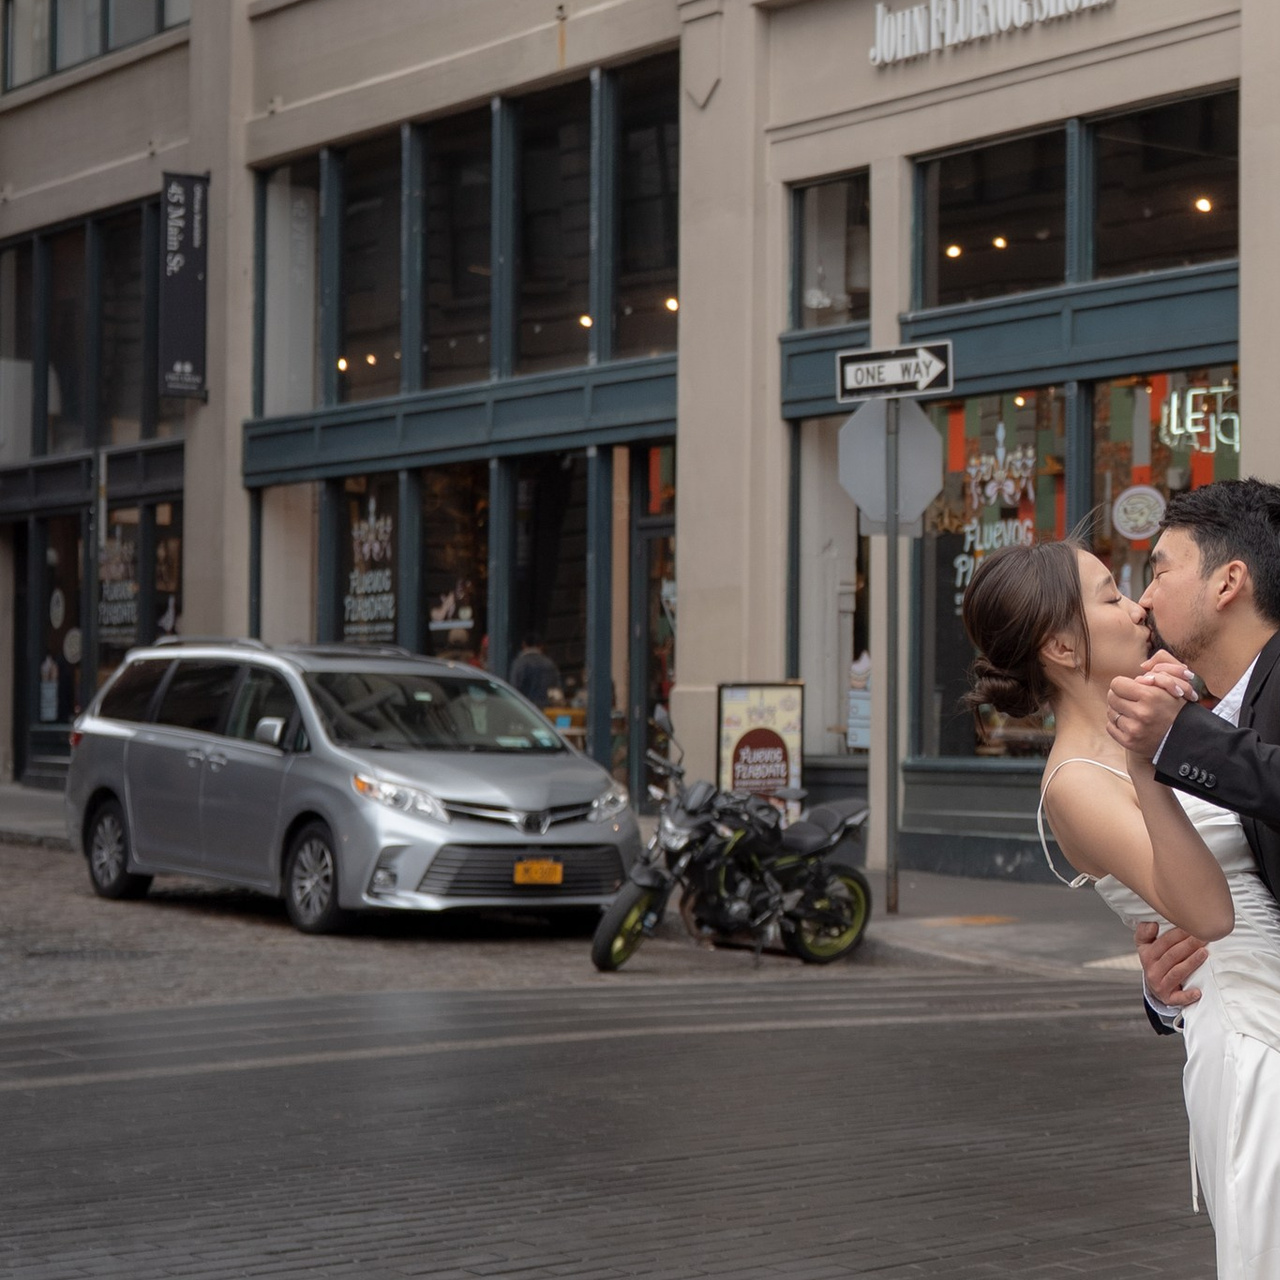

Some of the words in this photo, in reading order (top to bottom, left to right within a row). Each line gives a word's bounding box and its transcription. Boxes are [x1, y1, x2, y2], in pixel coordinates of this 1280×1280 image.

[869, 2, 929, 65] JOHN
[167, 181, 185, 204] 45
[166, 205, 186, 251] Main
[854, 365, 885, 386] ONE
[900, 361, 933, 380] WAY
